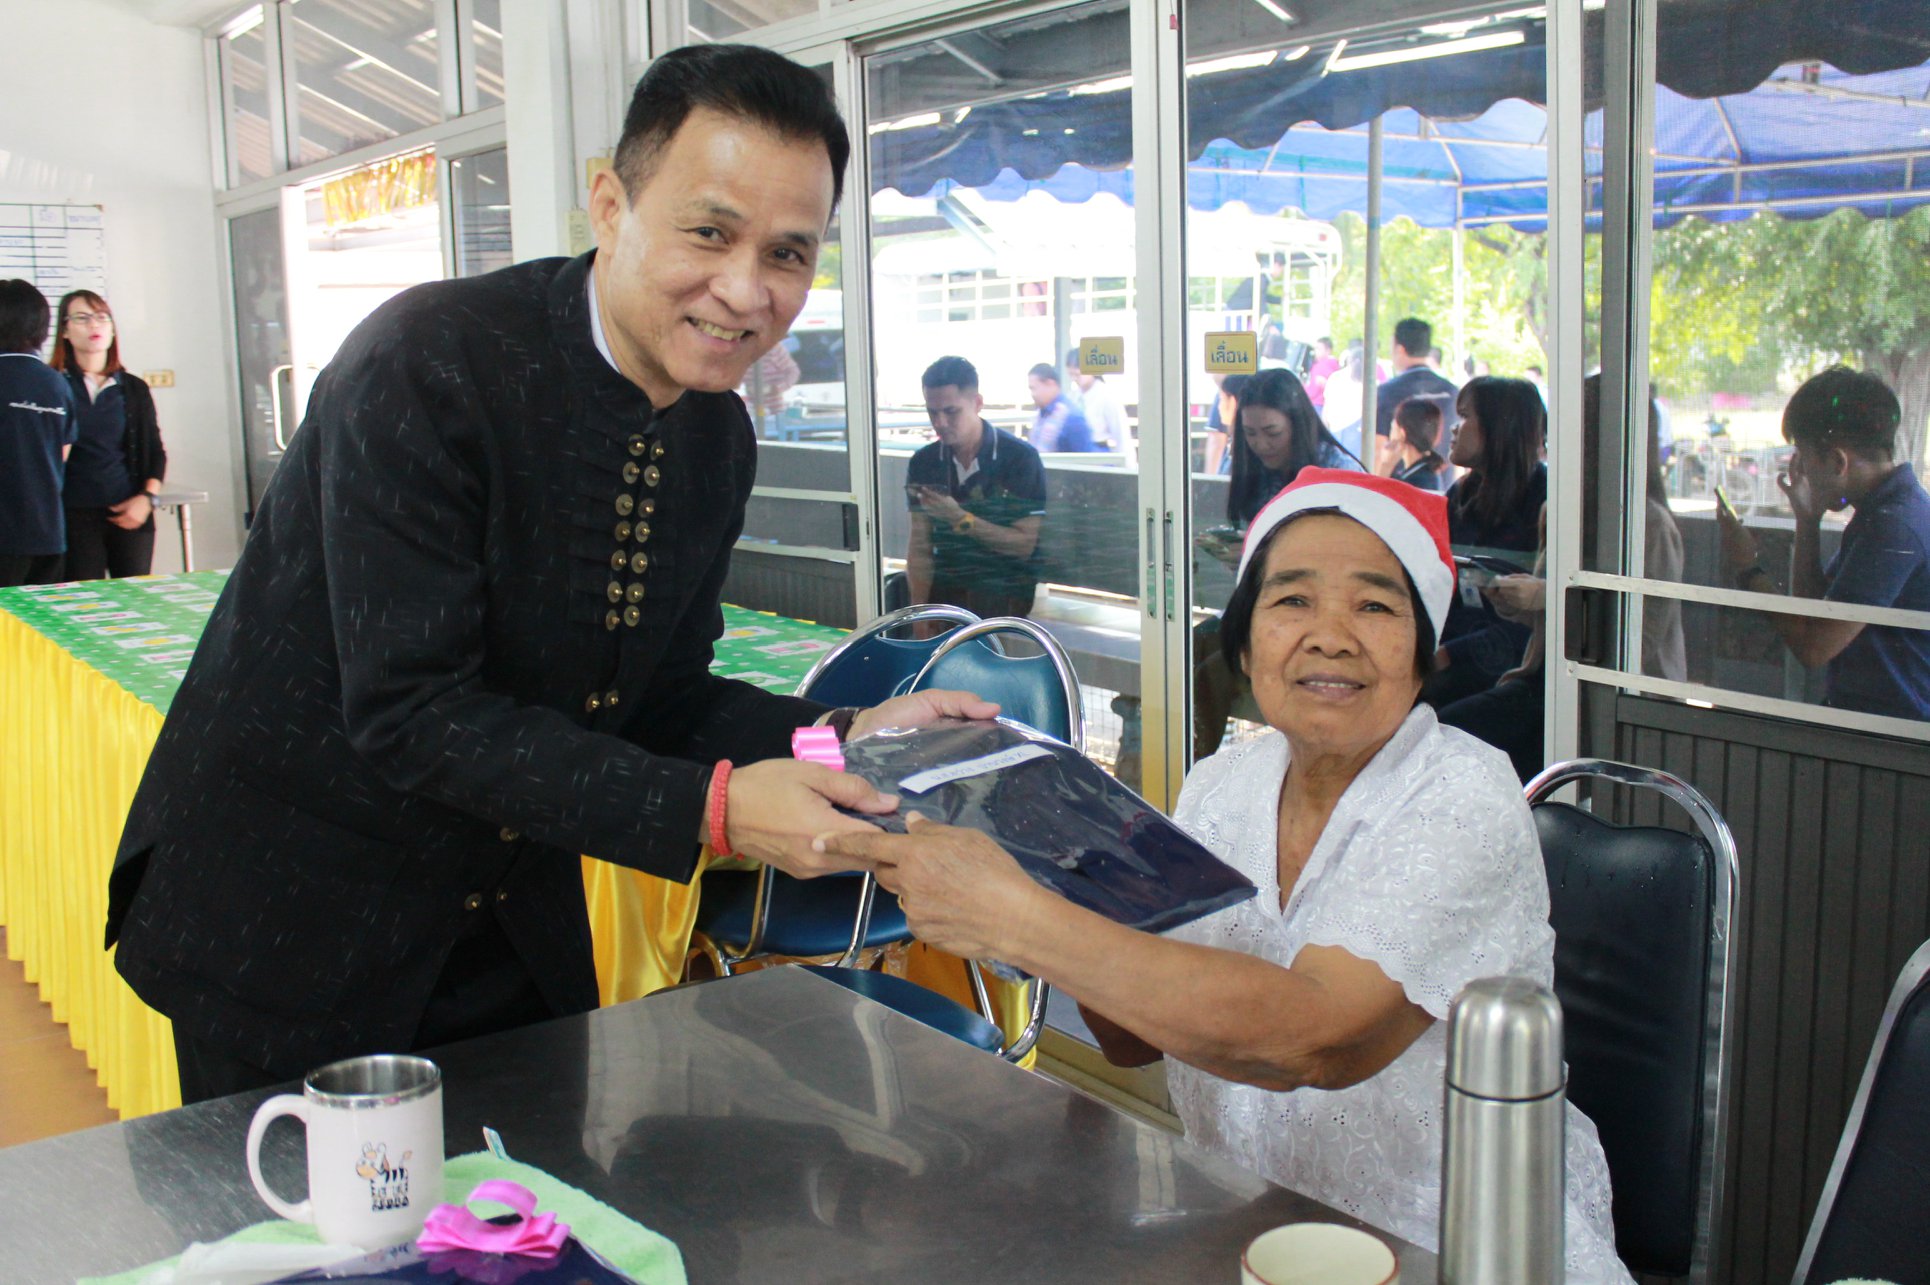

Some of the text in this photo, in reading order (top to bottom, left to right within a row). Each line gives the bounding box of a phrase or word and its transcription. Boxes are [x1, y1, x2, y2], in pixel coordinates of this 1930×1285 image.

[1085, 344, 1118, 366] เลื่อน
[1211, 340, 1248, 363] เลื่อน
